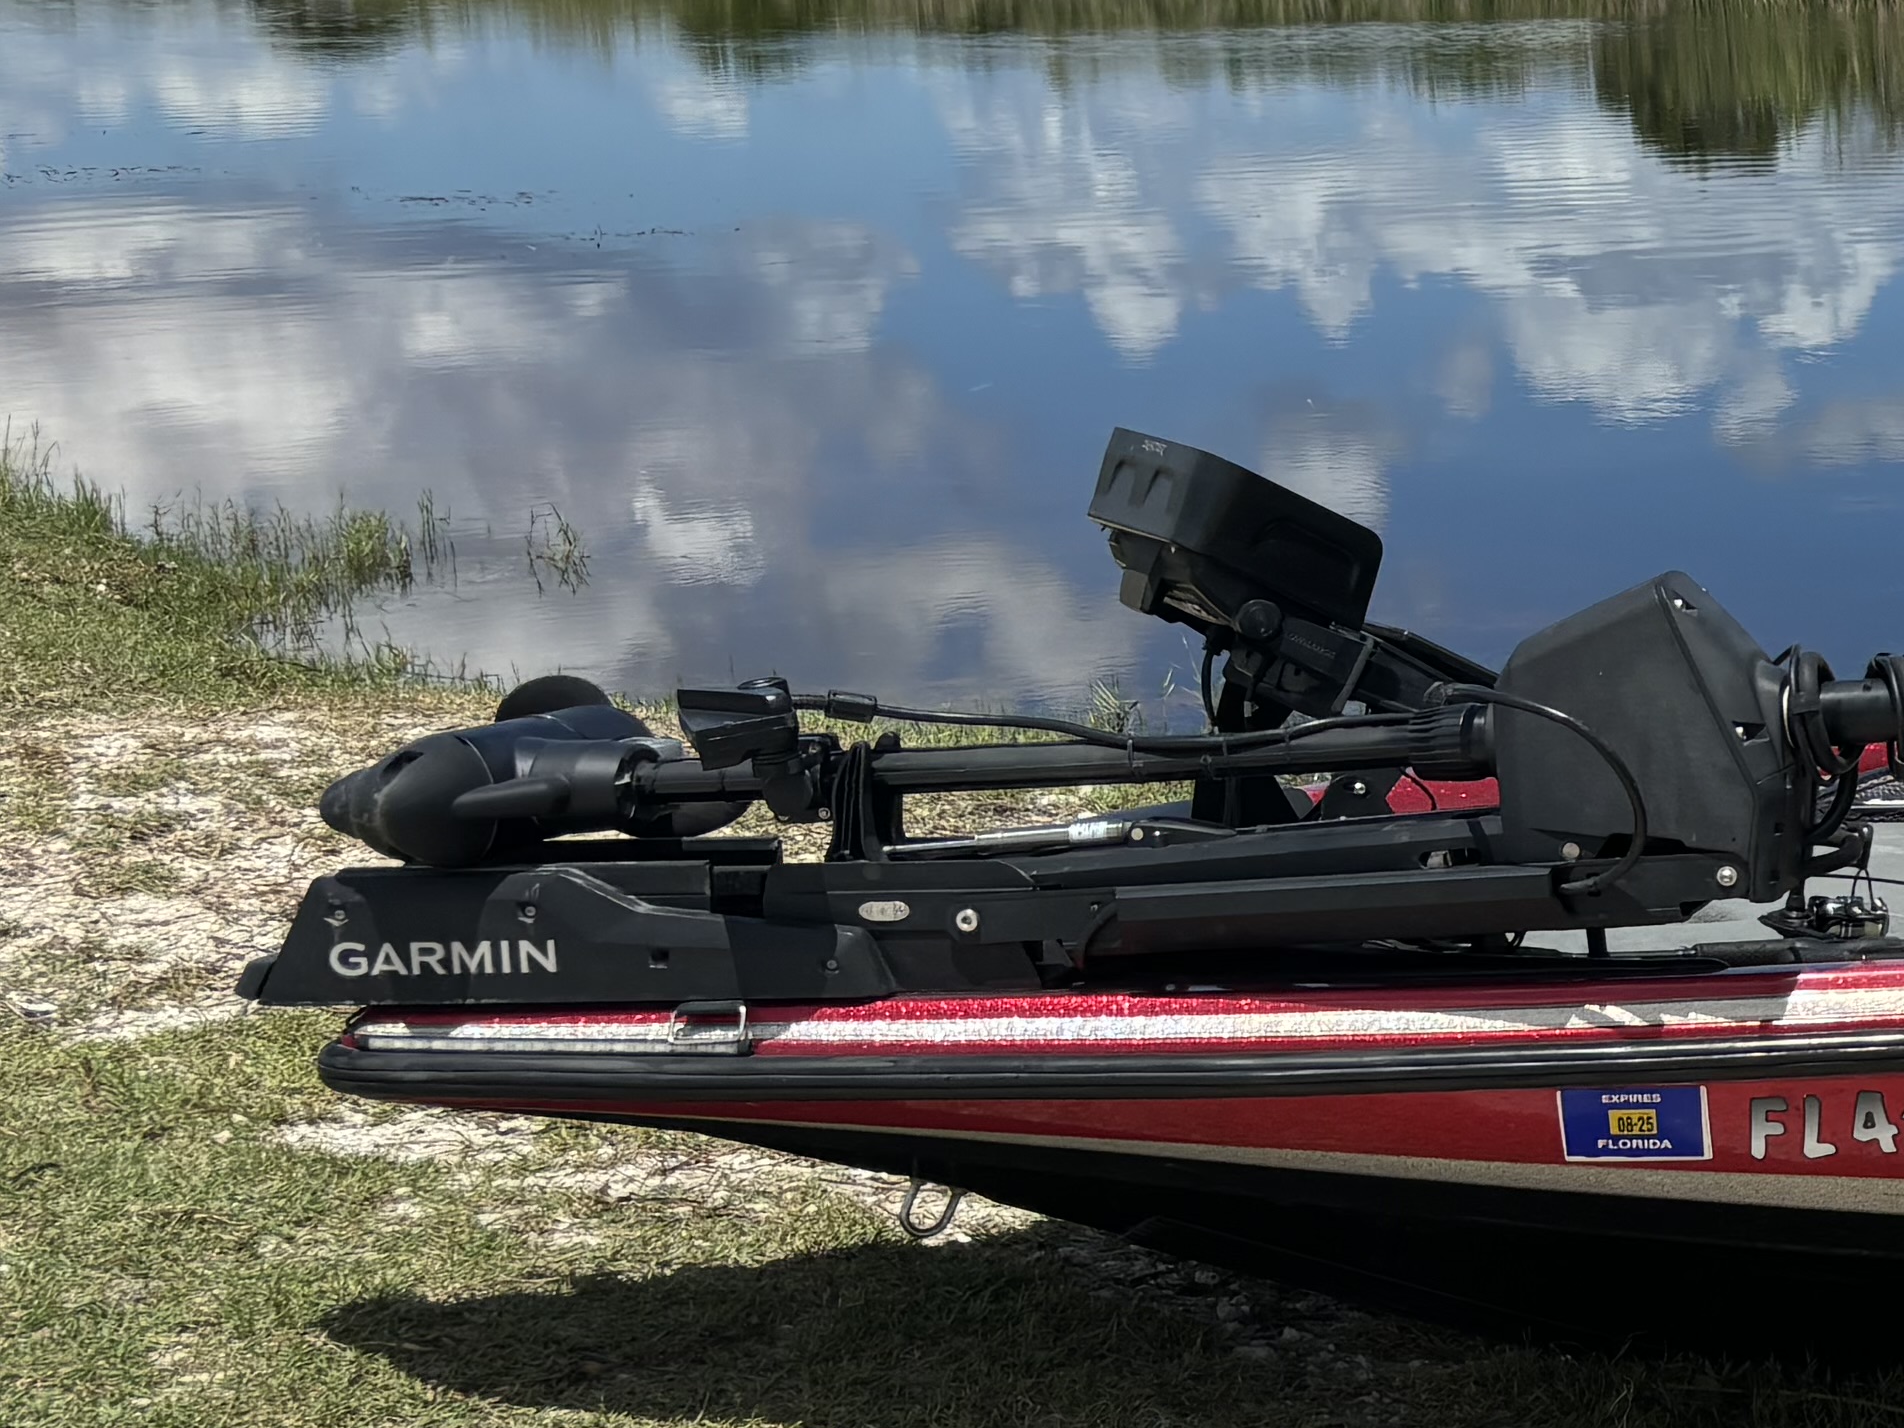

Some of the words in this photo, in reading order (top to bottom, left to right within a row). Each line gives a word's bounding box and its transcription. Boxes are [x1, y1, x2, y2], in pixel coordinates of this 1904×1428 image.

[328, 938, 558, 977] GARMIN
[1601, 1093, 1662, 1104] EXPIRES
[1617, 1116, 1654, 1133] 08-25
[1597, 1138, 1673, 1150] FLORIDA
